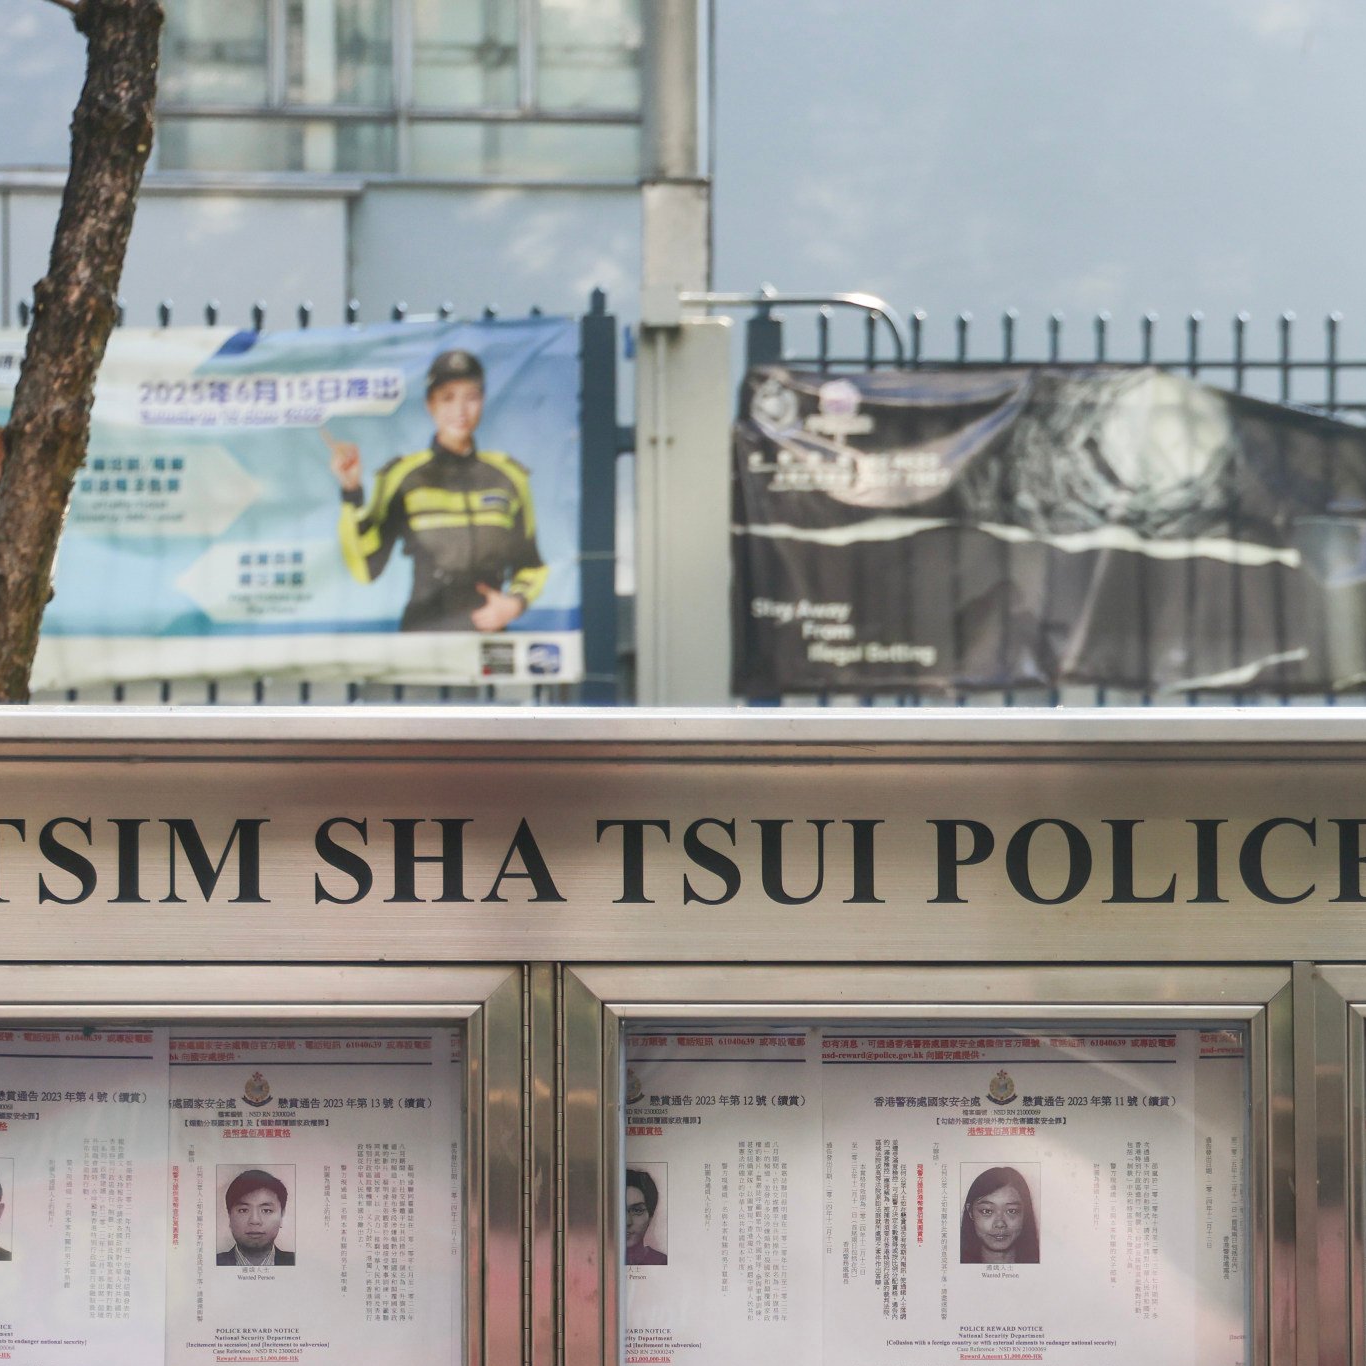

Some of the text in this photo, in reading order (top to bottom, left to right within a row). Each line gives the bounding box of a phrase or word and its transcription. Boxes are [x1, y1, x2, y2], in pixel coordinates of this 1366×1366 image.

[796, 598, 852, 624] Away
[802, 620, 855, 640] From
[315, 816, 567, 905] SHA
[597, 817, 885, 905] TSUI
[41, 1092, 61, 1101] 2023
[65, 1092, 86, 1102] 年第
[89, 1093, 93, 1101] 4
[650, 1095, 753, 1106] 懸賞通告 2023 年第 12
[874, 1096, 1124, 1107] 香港警務處國家安全處 懸賞通告 2023 年第 11
[278, 1098, 380, 1108] 懸賞通告 2023 年第 13
